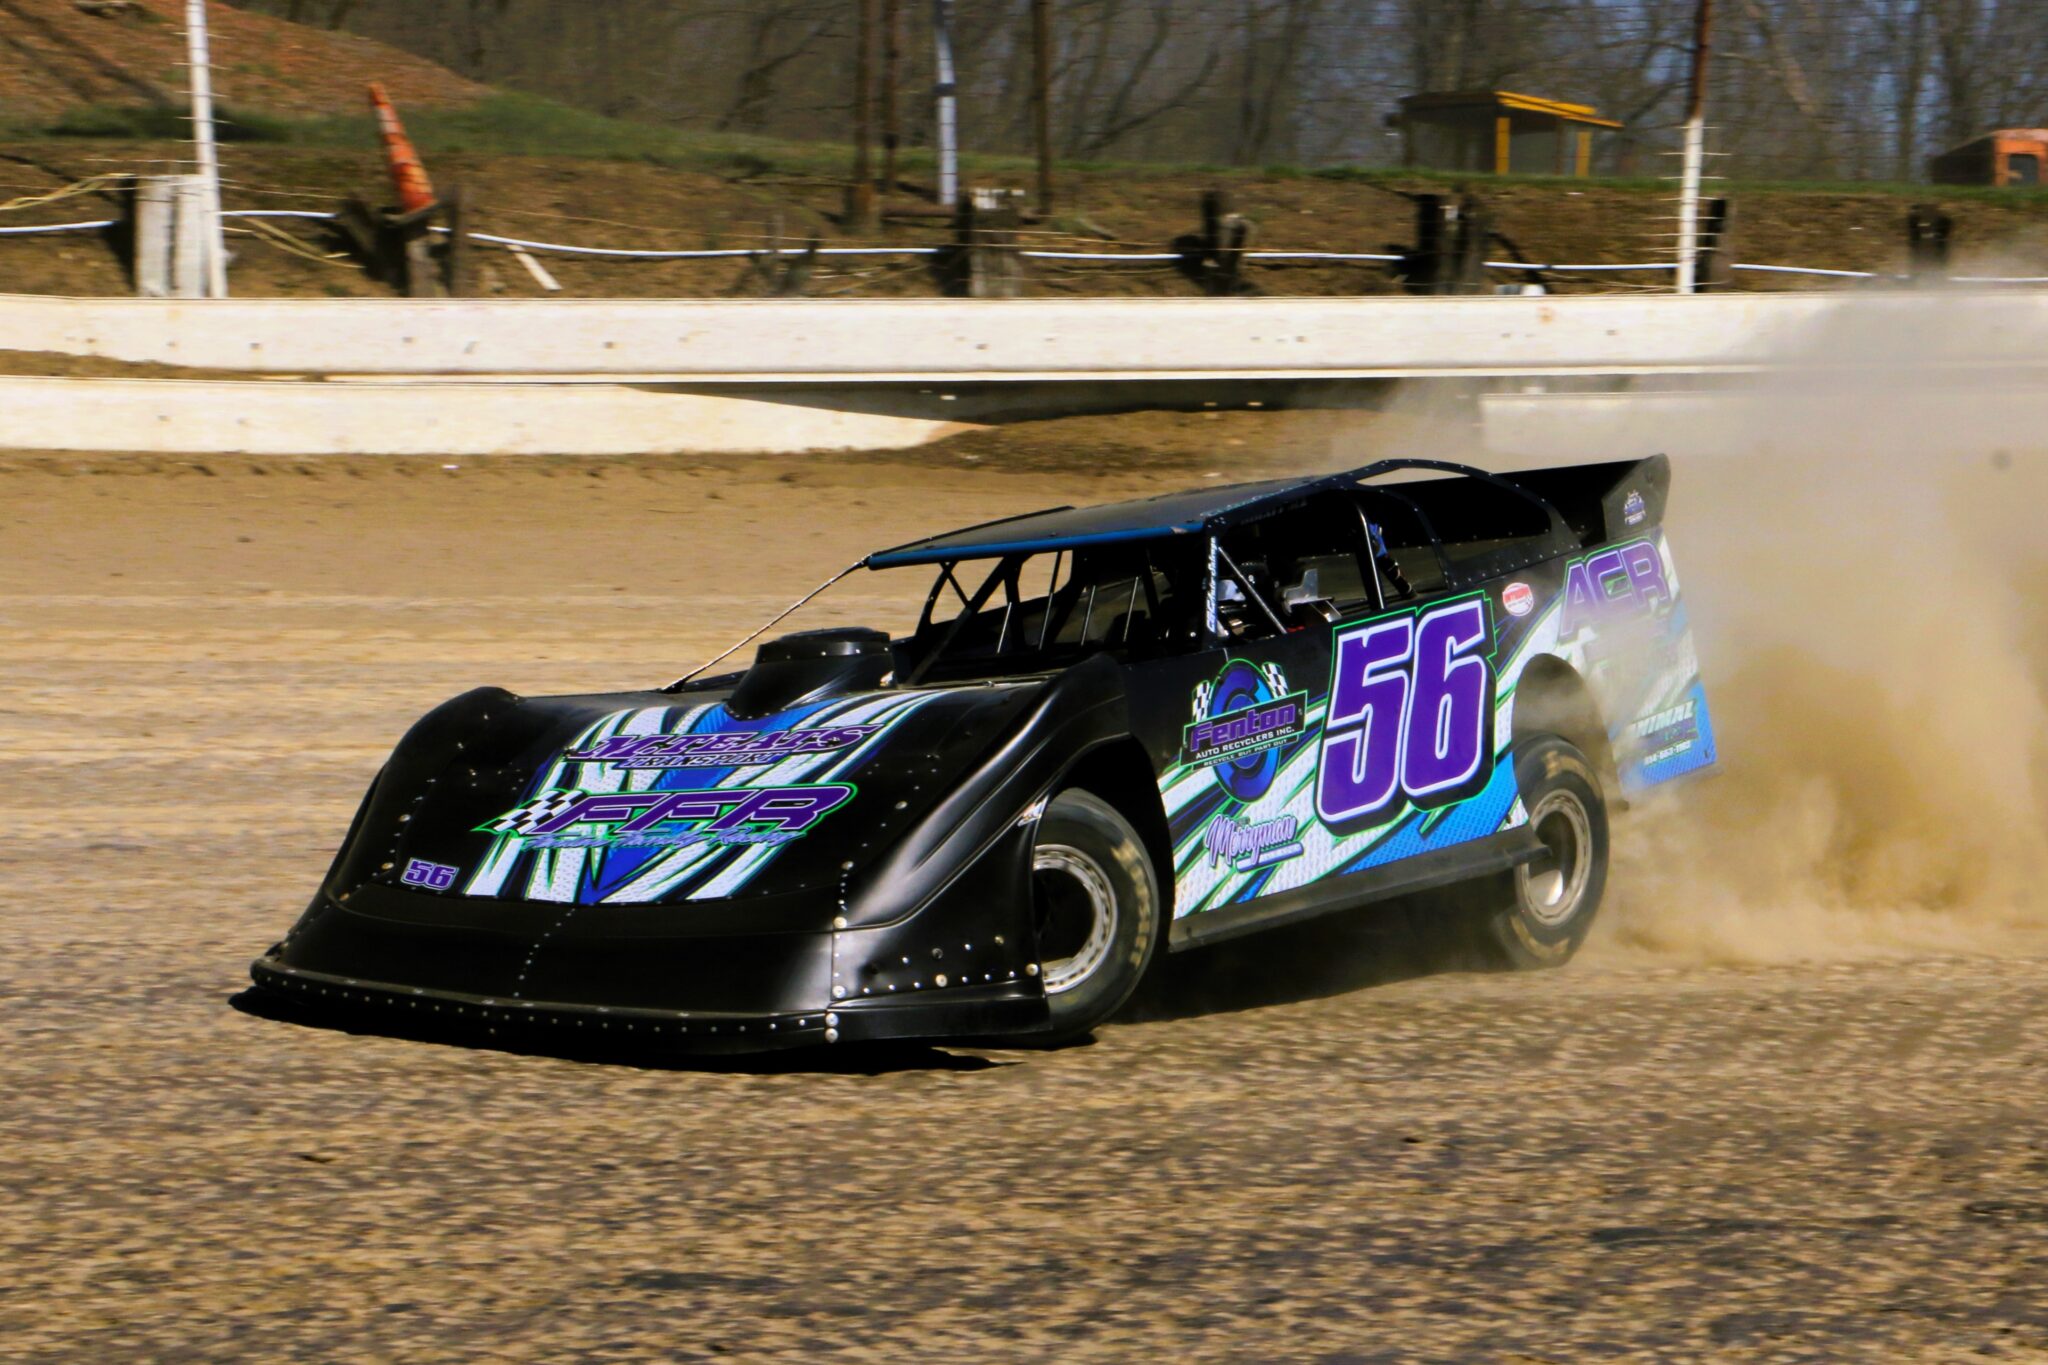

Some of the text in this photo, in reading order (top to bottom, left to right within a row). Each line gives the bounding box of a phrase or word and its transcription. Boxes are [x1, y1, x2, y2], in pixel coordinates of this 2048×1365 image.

[1559, 541, 1672, 636] ACR
[1190, 703, 1296, 752] Fenton
[1317, 599, 1487, 823] 56
[1195, 726, 1295, 759] AUTO RECYCLERS INC.
[524, 786, 850, 834] FFR
[401, 857, 459, 890] 56
